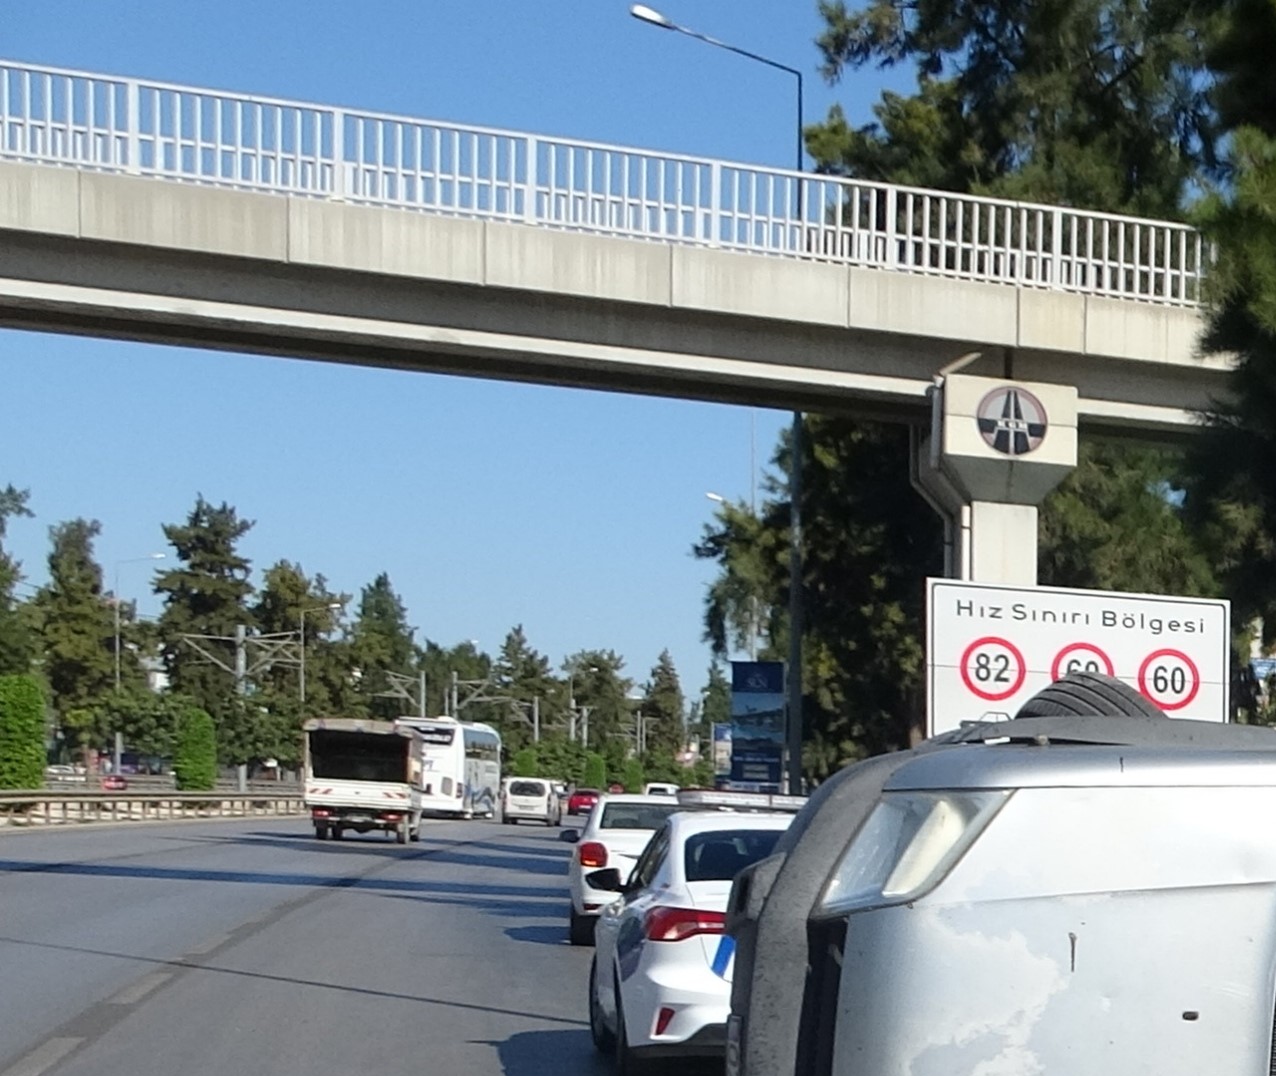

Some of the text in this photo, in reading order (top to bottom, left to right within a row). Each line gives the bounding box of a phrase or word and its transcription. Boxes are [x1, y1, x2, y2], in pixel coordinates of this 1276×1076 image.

[956, 599, 1205, 635] Hız Sınırı Bölgesi
[975, 653, 1010, 683] 82
[1153, 666, 1185, 694] 60
